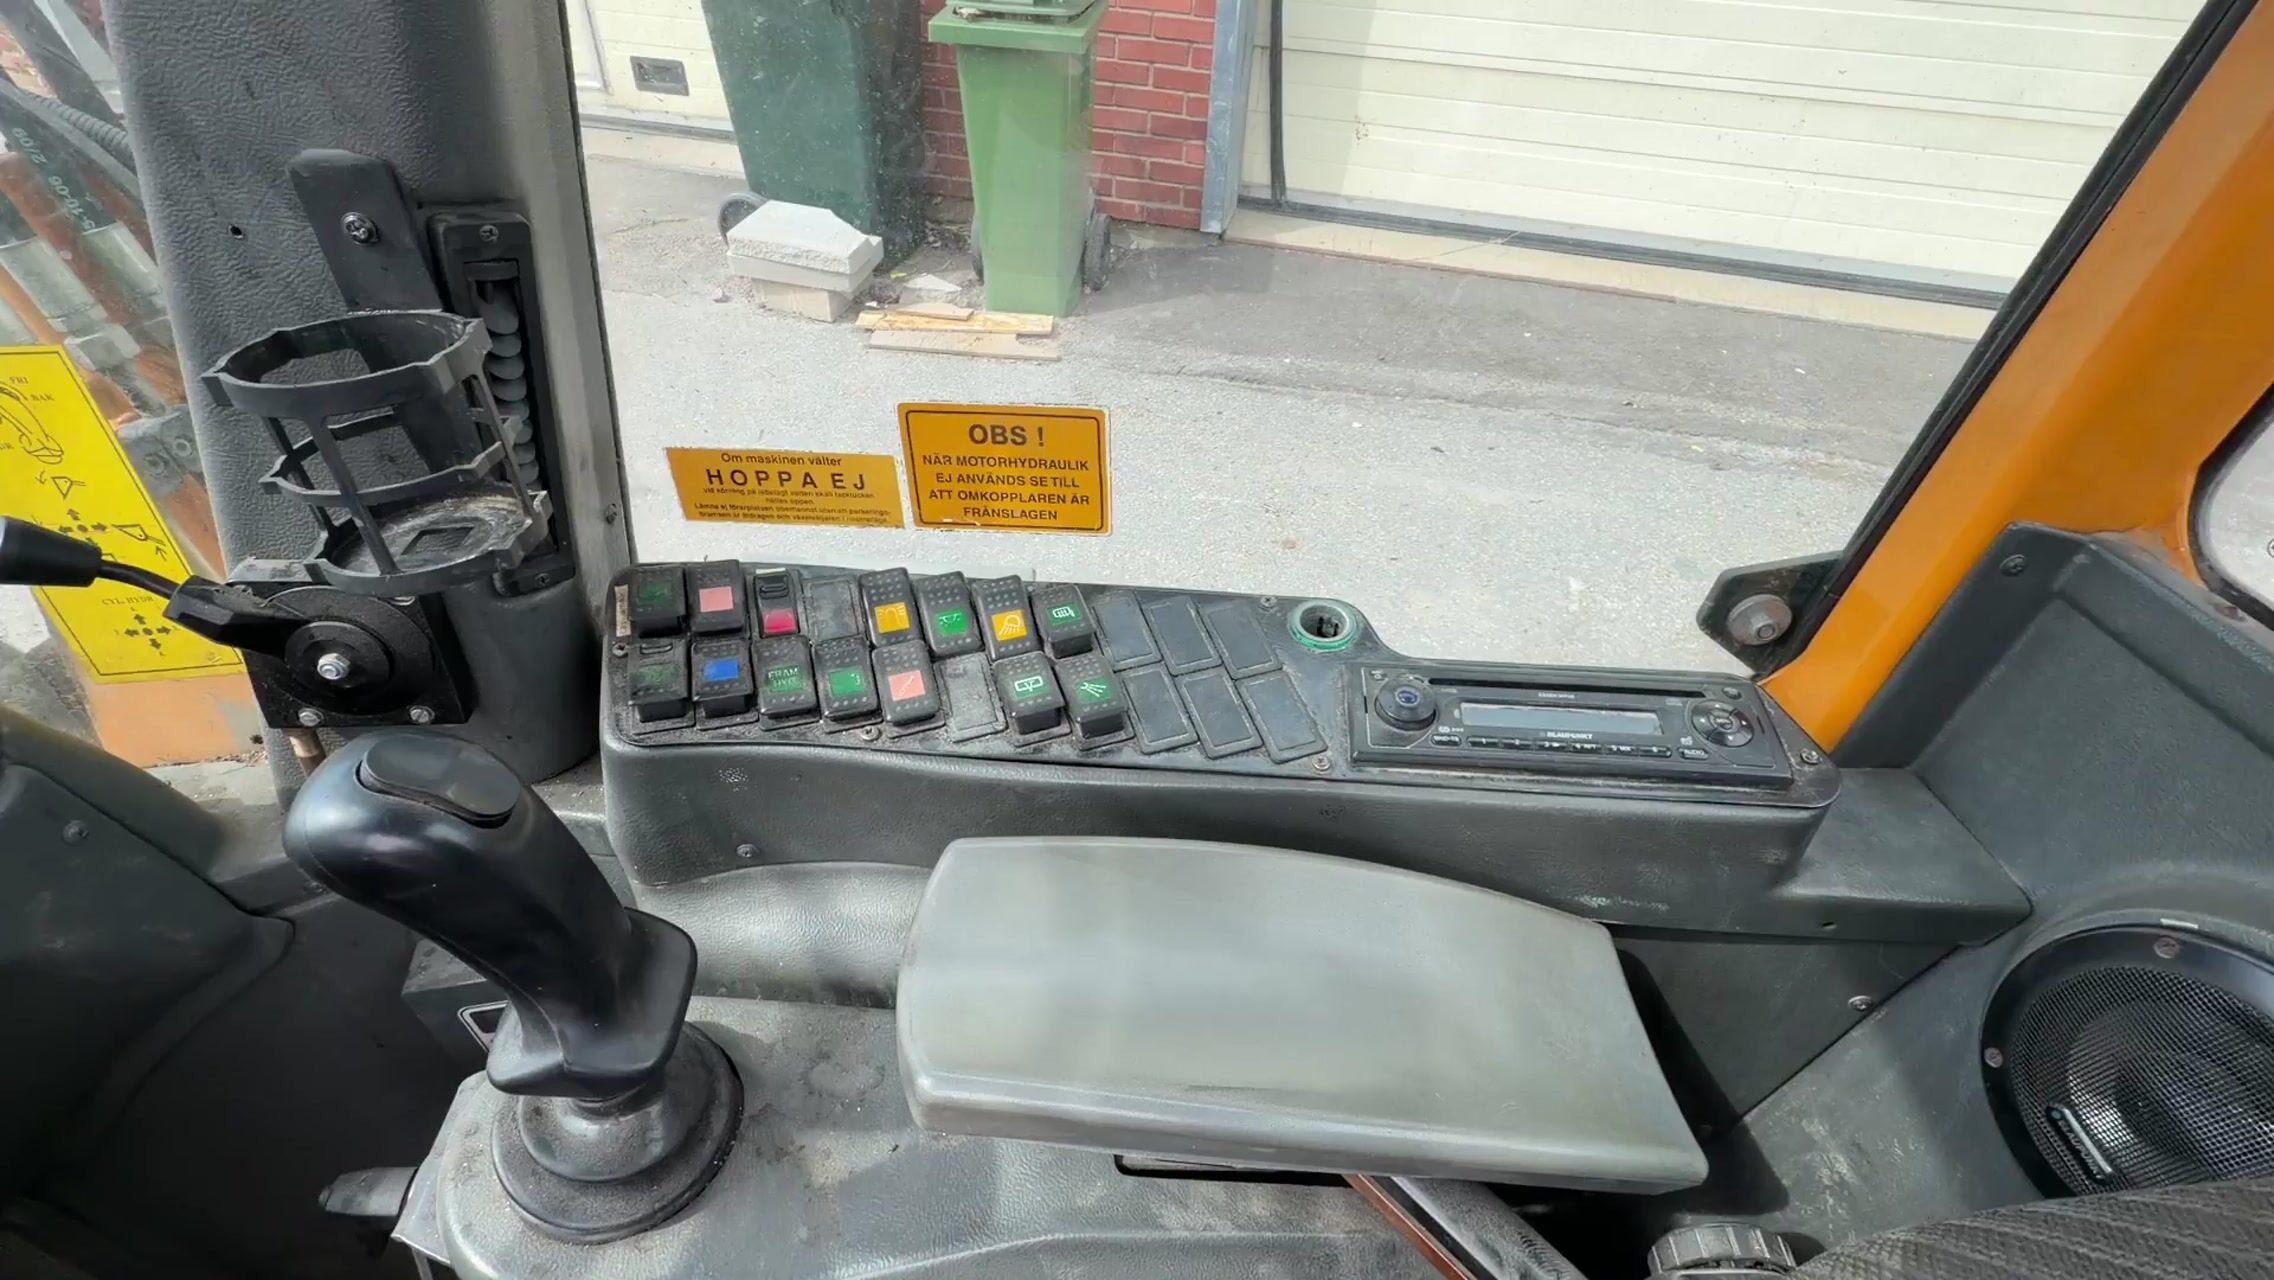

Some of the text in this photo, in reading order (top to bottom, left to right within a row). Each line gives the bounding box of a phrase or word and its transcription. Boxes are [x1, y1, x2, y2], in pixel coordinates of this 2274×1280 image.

[968, 424, 1044, 447] OBS !
[721, 453, 842, 466] Om maskinen välter
[923, 452, 1089, 471] NÄR MOTORHYDRAULIK
[706, 468, 865, 490] HOPPA EJ
[936, 472, 1080, 488] EJ ANVÄNDS SE TILL
[929, 489, 1090, 505] ATT OMKOPPLAREN ÄR
[963, 505, 1058, 521] FRÅNSLAGEN
[1546, 731, 1593, 740] BLAUPUNKT
